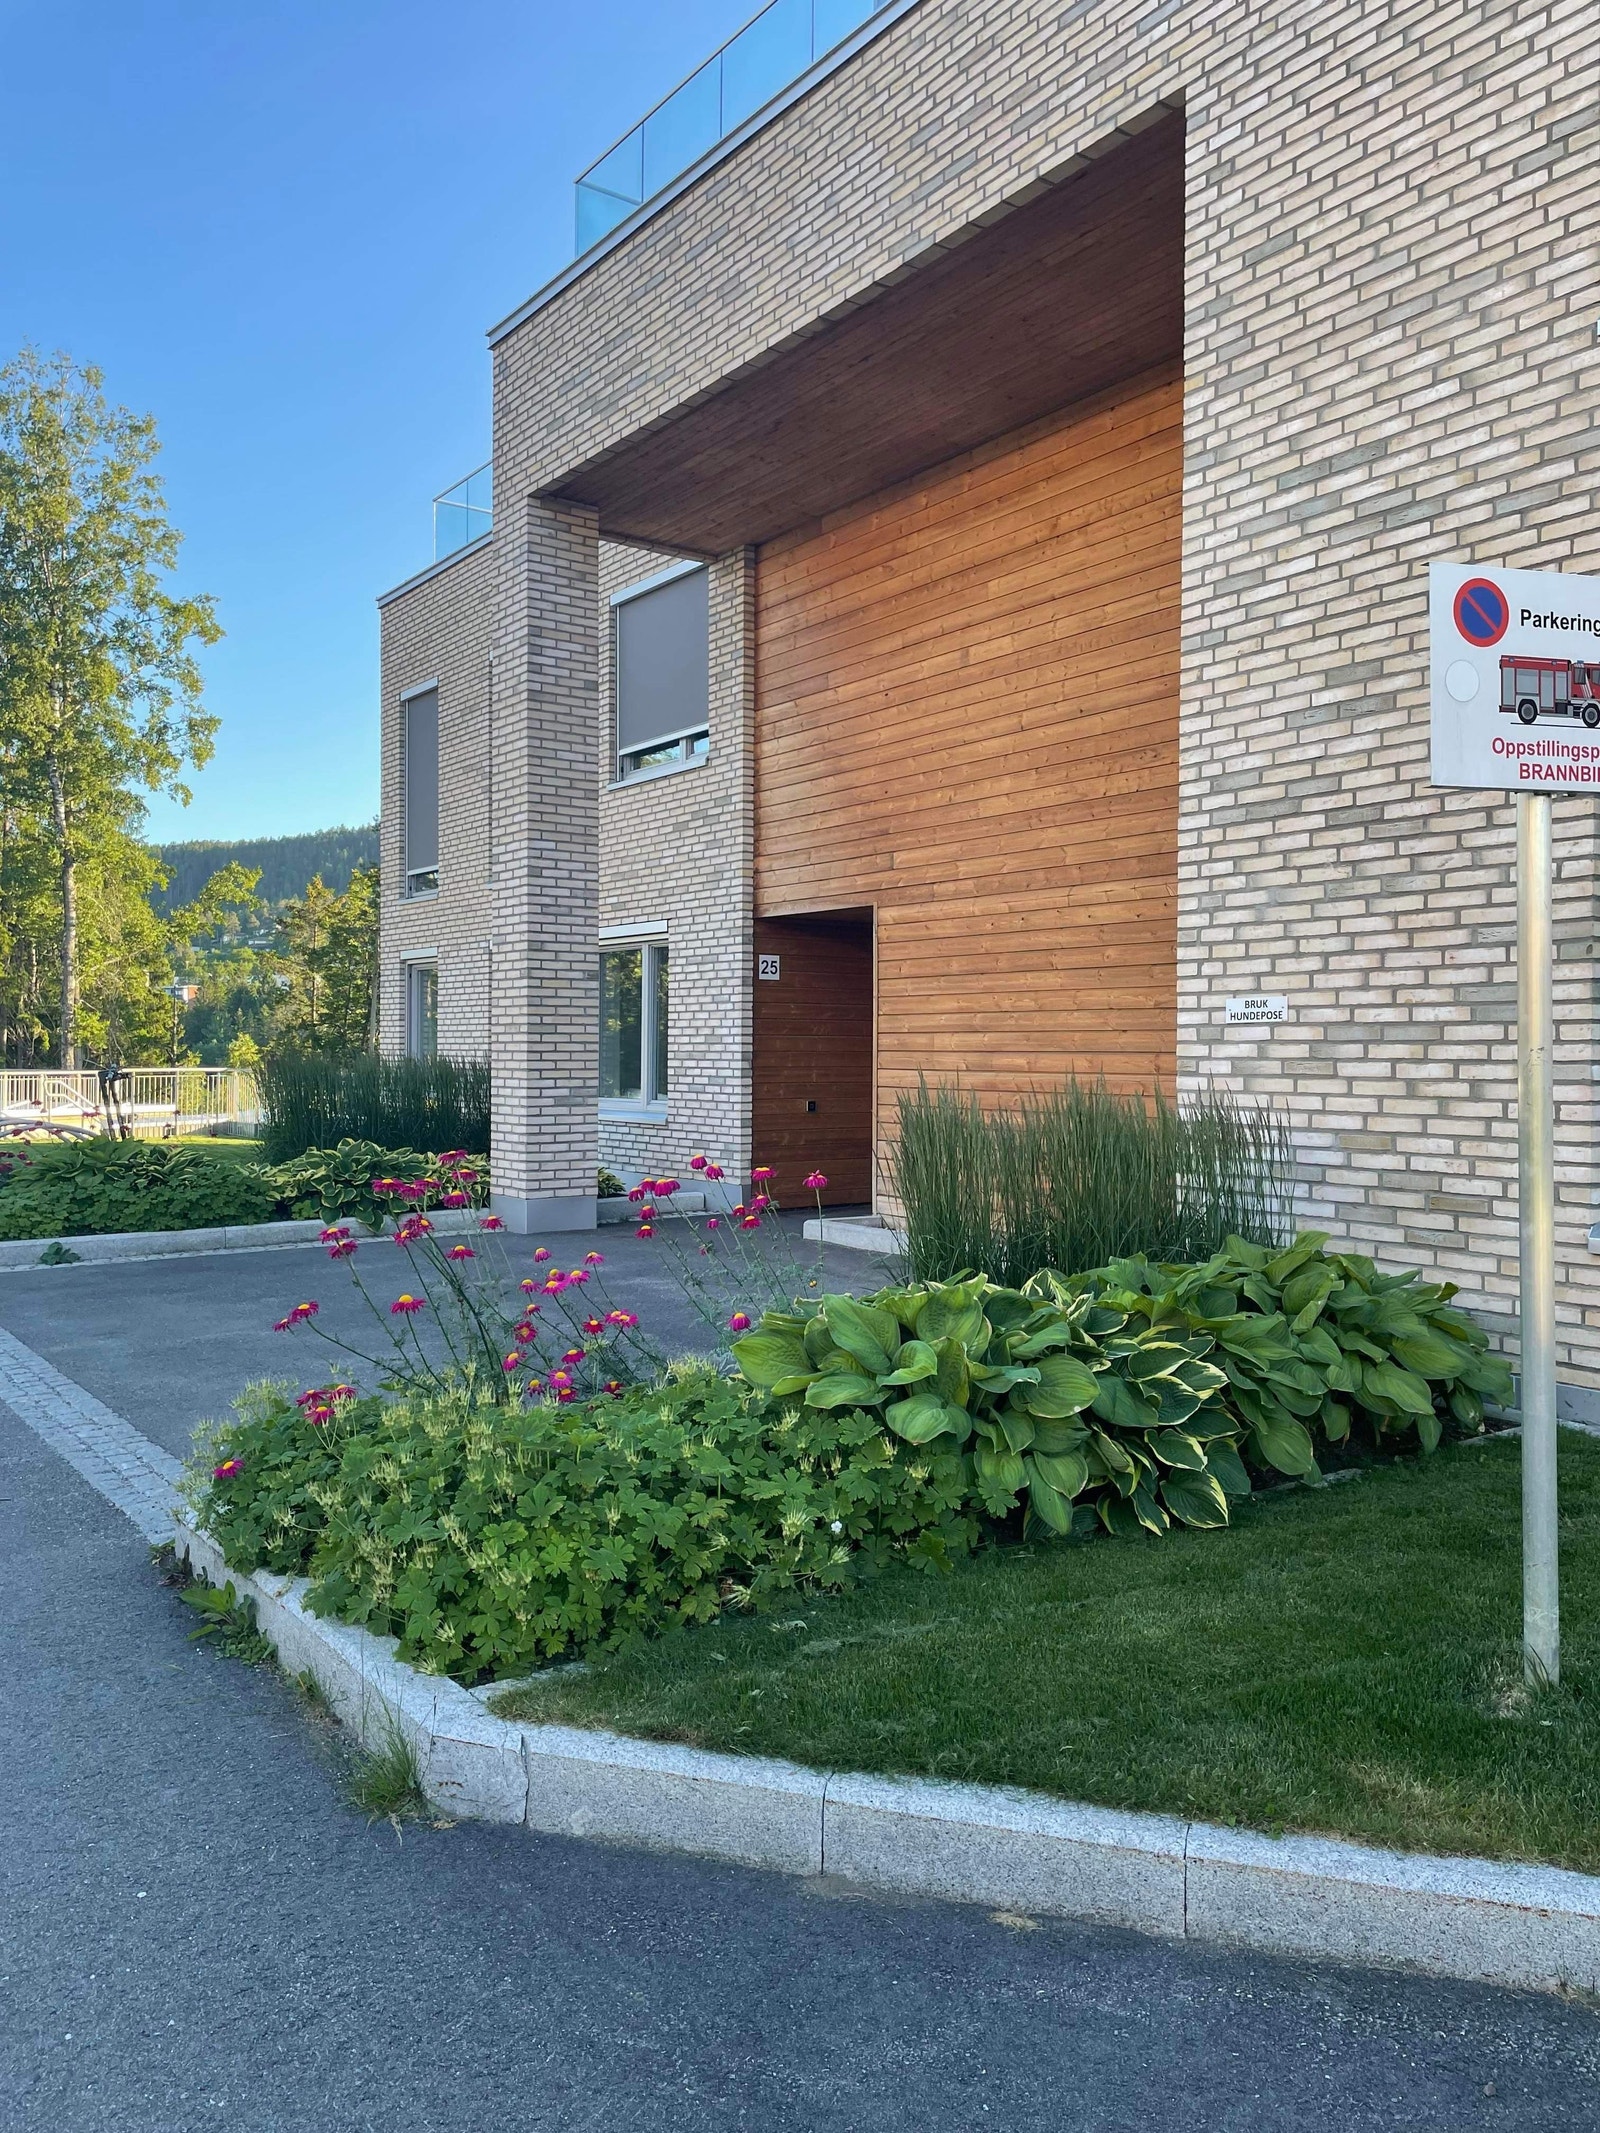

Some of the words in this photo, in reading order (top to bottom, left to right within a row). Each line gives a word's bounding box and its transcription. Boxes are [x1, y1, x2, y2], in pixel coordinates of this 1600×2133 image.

[760, 960, 778, 975] 25
[1244, 999, 1269, 1009] BRUK
[1230, 1010, 1283, 1021] HUNDEPOSE
